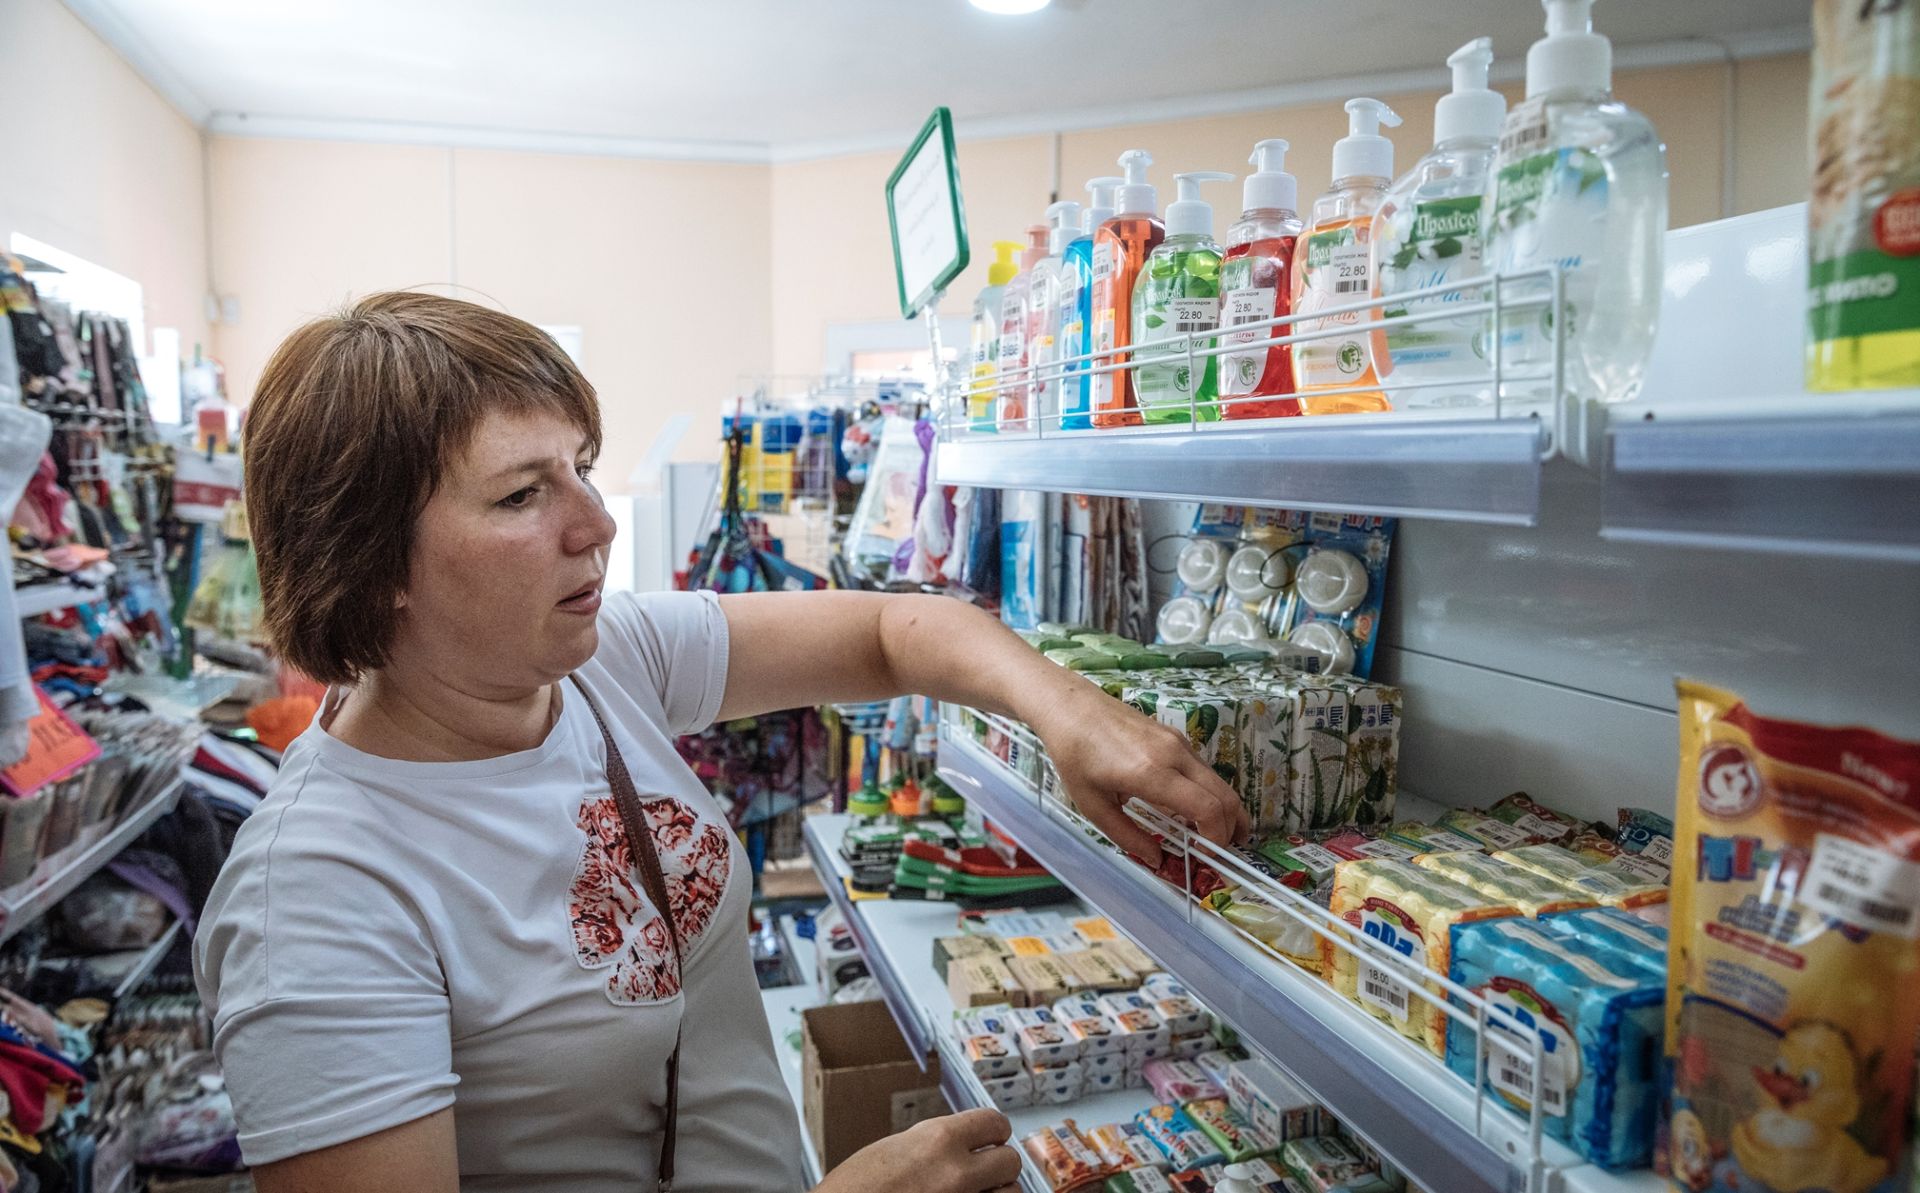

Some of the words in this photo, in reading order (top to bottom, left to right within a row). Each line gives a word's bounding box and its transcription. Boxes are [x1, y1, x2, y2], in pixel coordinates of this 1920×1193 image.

[1339, 265, 1367, 277] 22.80
[1235, 303, 1252, 313] 22.80
[1179, 310, 1203, 320] 22.80
[1369, 968, 1389, 985] 18.00
